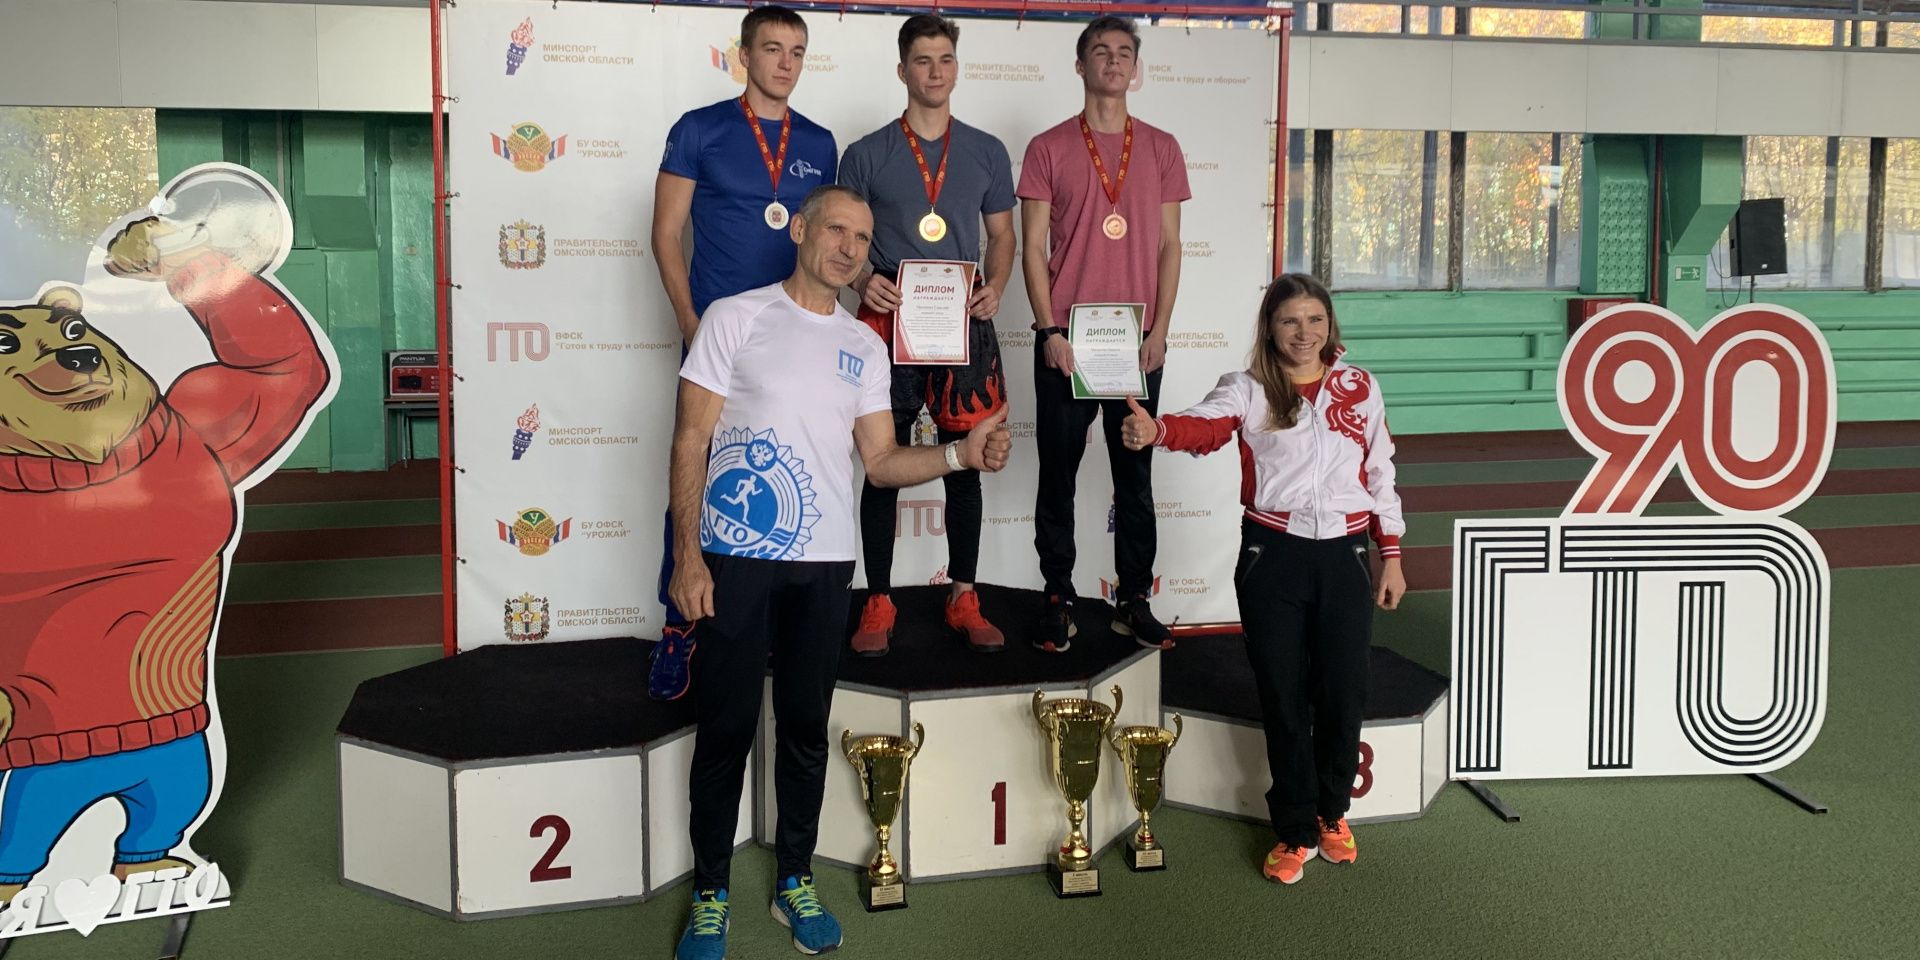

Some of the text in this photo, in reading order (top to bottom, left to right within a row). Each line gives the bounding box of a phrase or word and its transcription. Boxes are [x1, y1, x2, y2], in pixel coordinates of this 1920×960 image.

[543, 44, 597, 53] МИНСПОРТ
[543, 53, 634, 65] ОМСКОЙ ОБЛАСТИ
[964, 63, 1040, 73] ПРАВИТЕЛЬСТВО
[964, 72, 1045, 82] ОМСКОЙ ОБЛАСТИ
[577, 139, 620, 149] БУ ОФСК
[554, 239, 638, 248] ПРАВИТЕЛЬСТВО
[554, 247, 644, 257] ОМСКОЙ ОБЛАСТИ
[1183, 250, 1216, 258] РОЖАЙ"
[914, 285, 955, 294] ДИПЛОМ
[555, 332, 583, 340] ВФСК
[1086, 328, 1126, 336] ДИПЛОМ
[1166, 332, 1224, 340] АВИТЕЛЬСТВО
[487, 322, 550, 361] ГТО
[1167, 340, 1229, 349] СКОЙ ОБЛАСТИ
[596, 343, 622, 352] труду
[839, 349, 864, 378] ГТО
[1564, 309, 1830, 514] 90
[549, 428, 602, 436] МИНСПОРТ
[549, 436, 639, 446] ОМСКОЙ ОБЛАСТИ
[1155, 502, 1182, 510] СПОРТ
[1174, 510, 1212, 518] ОБЛАСТИ
[582, 520, 624, 530] БУ ОФСК
[988, 517, 1011, 525] труду
[582, 529, 632, 540] "УРОЖАЙ"
[713, 516, 749, 544] ГТО
[1169, 578, 1180, 586] БУ
[557, 607, 640, 618] ПРАВИТЕЛЬСТВО
[557, 616, 646, 627] ОМСКОЙ ОБЛАСТИ
[1456, 523, 1823, 773] ГТО
[1350, 741, 1374, 799] 3
[991, 781, 1007, 845] 1
[529, 814, 572, 883] 2
[2, 862, 220, 934] Я ГТО
